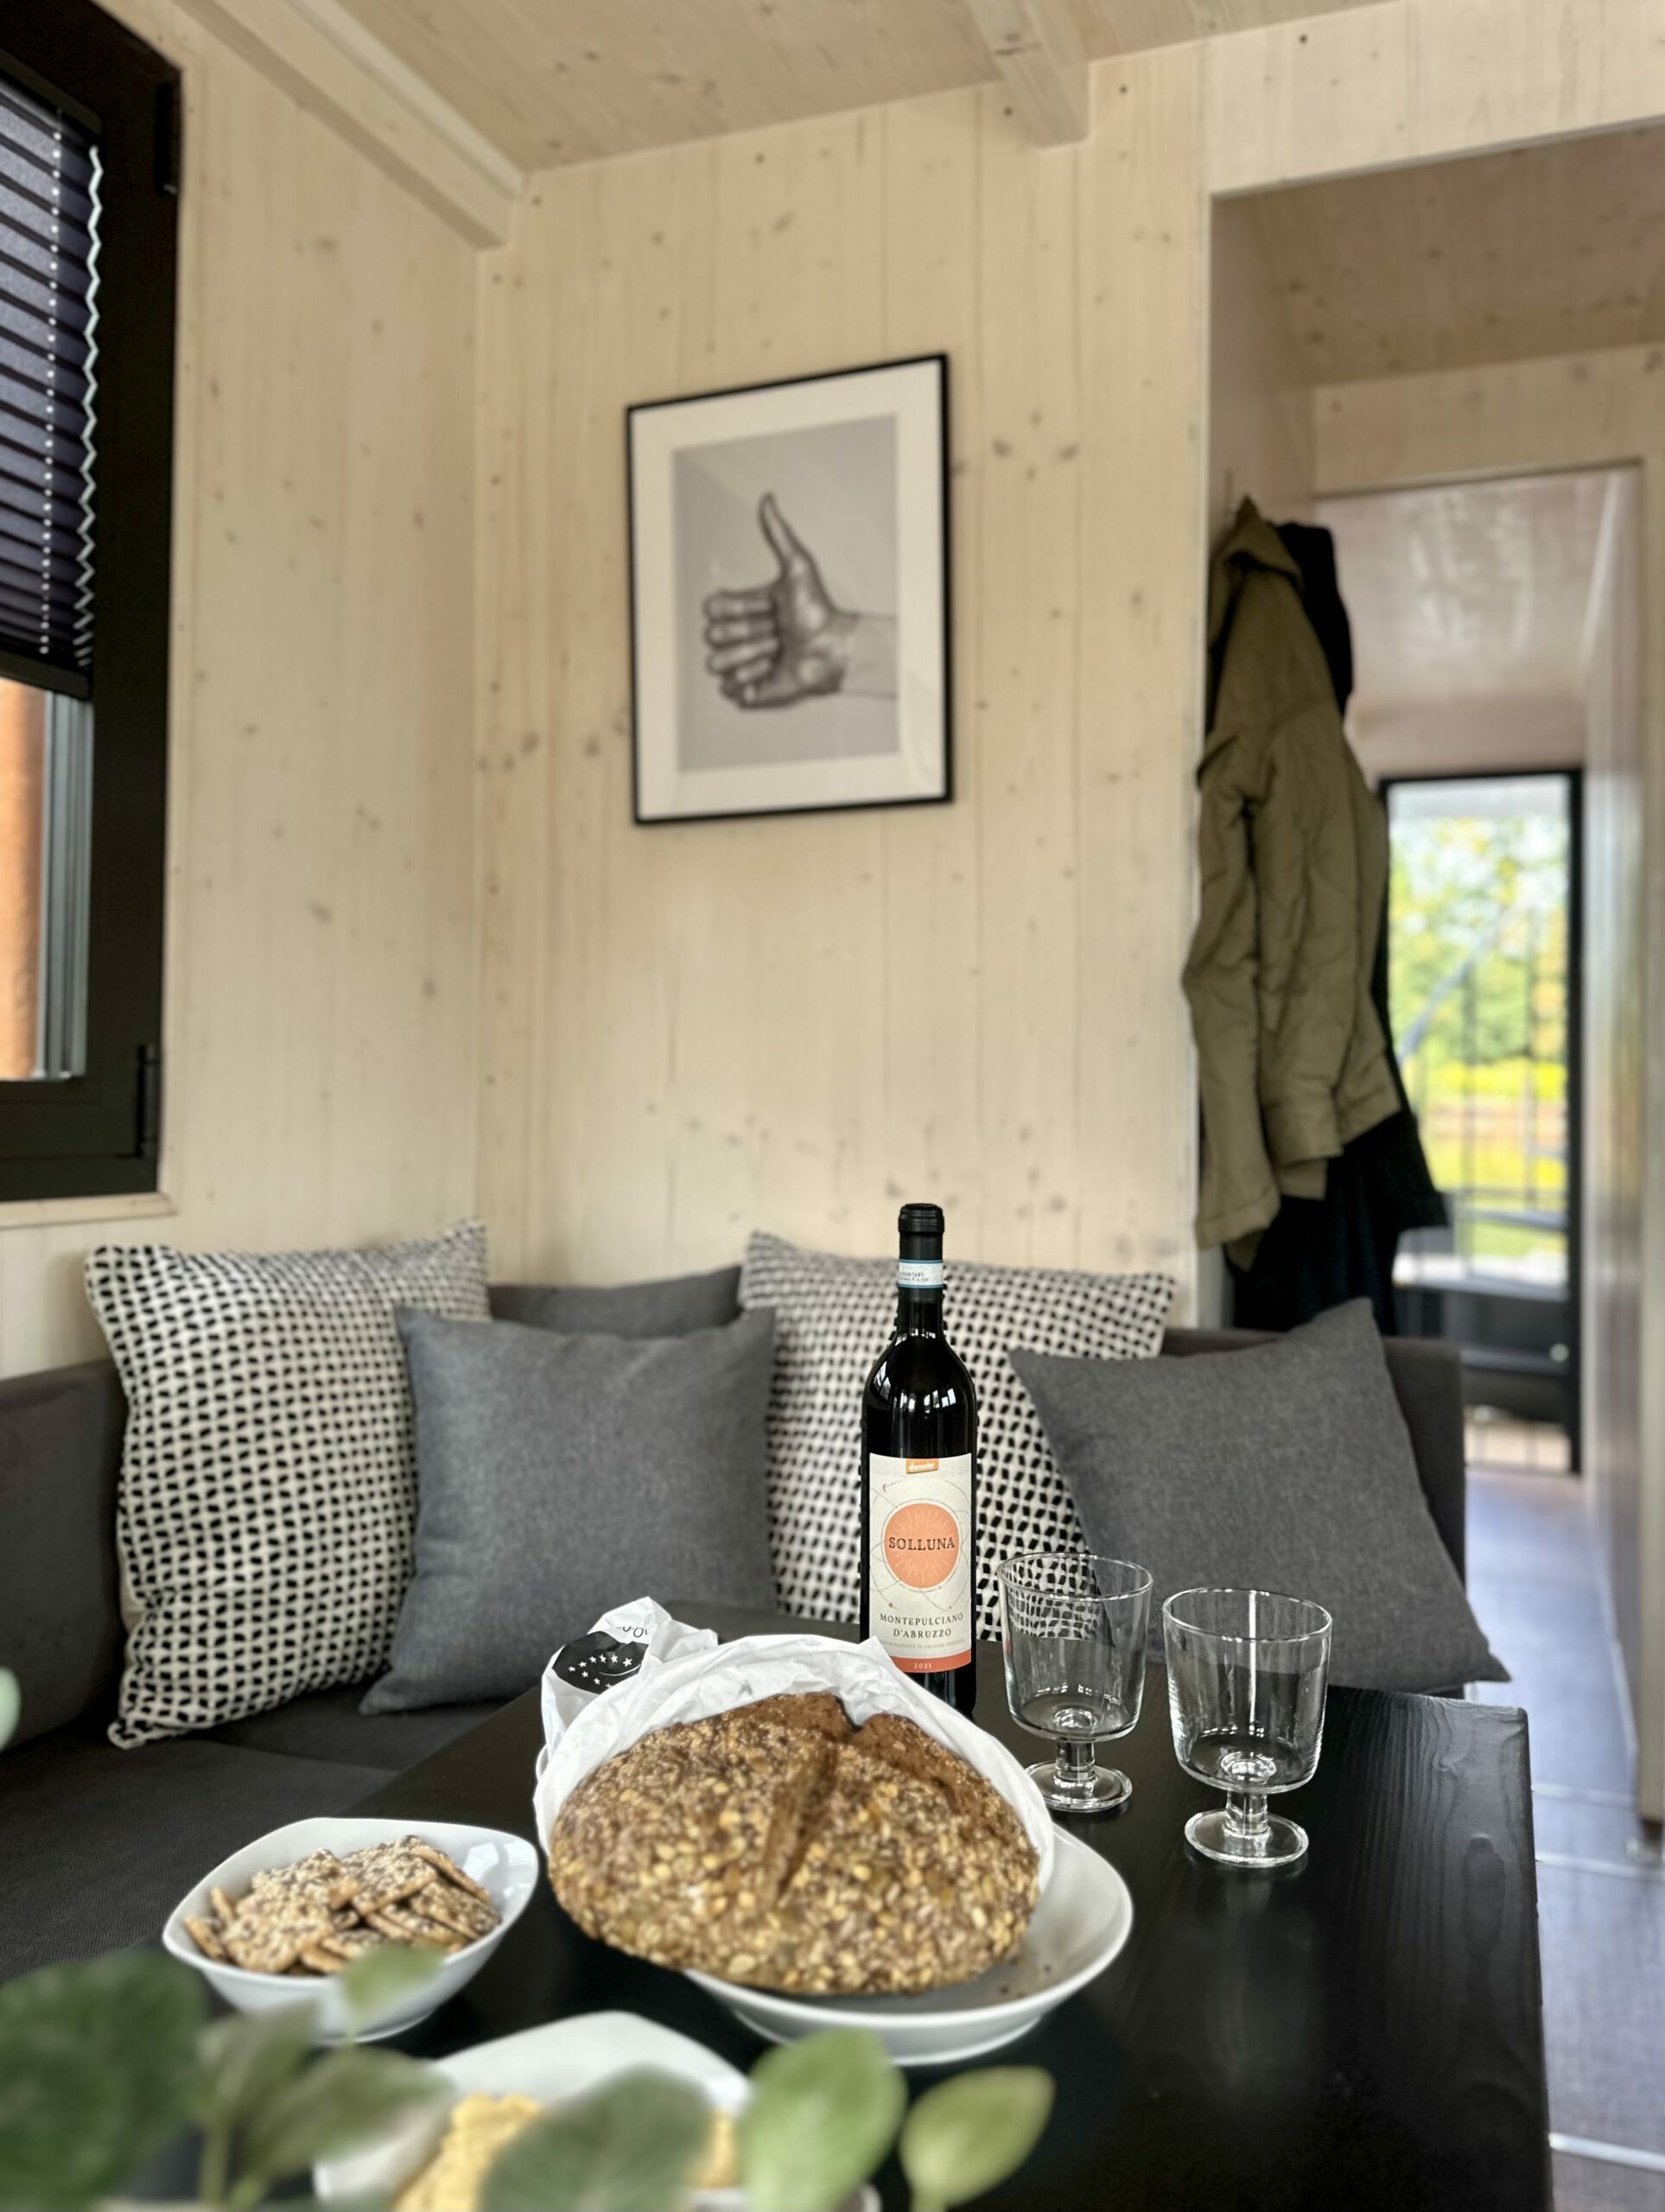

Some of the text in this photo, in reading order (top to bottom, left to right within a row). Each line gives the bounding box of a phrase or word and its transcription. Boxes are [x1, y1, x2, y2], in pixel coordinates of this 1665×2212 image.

[889, 1537, 956, 1551] SOLLUNA
[880, 1612, 963, 1625] MONTEPULCIANO
[893, 1628, 951, 1638] D'ABRUZZO
